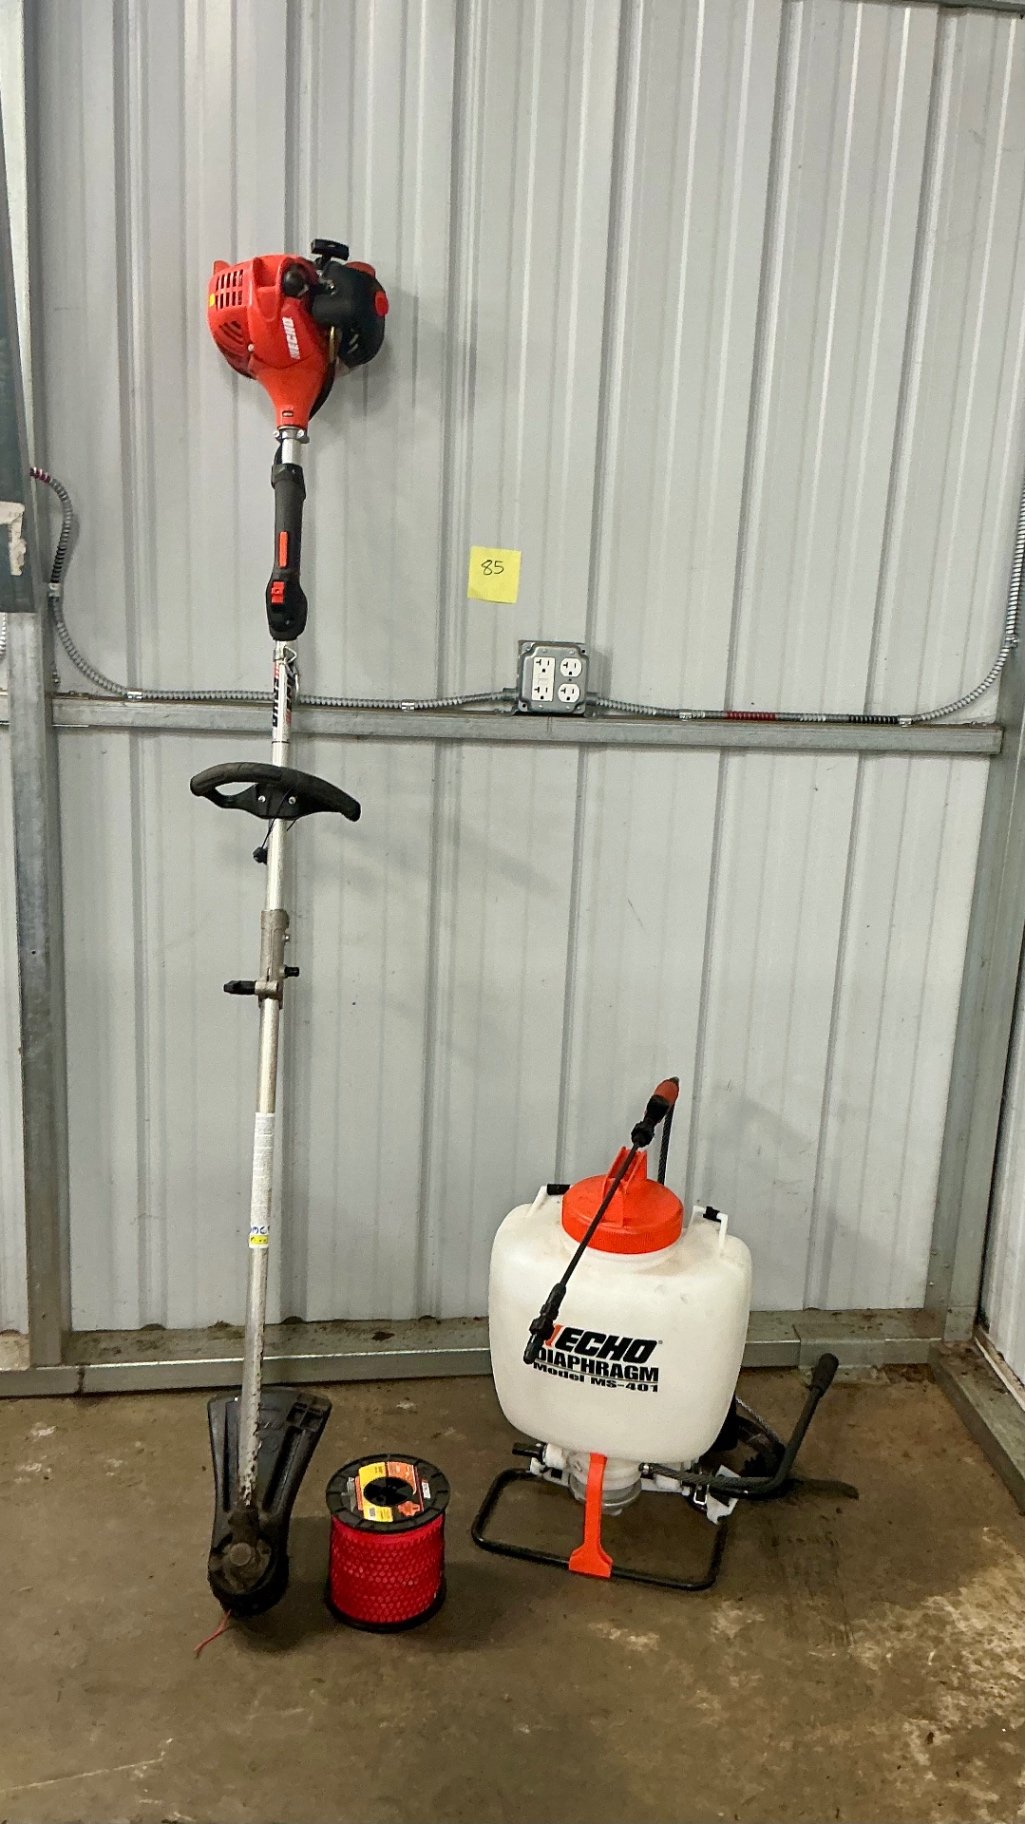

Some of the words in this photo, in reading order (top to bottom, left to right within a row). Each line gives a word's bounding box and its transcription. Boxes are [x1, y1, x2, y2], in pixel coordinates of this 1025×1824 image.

[481, 559, 505, 576] 85
[555, 1326, 657, 1364] ECHO
[533, 1362, 585, 1382] Model
[590, 1376, 658, 1393] MS-401
[537, 1349, 659, 1382] DIAPHRAGM
